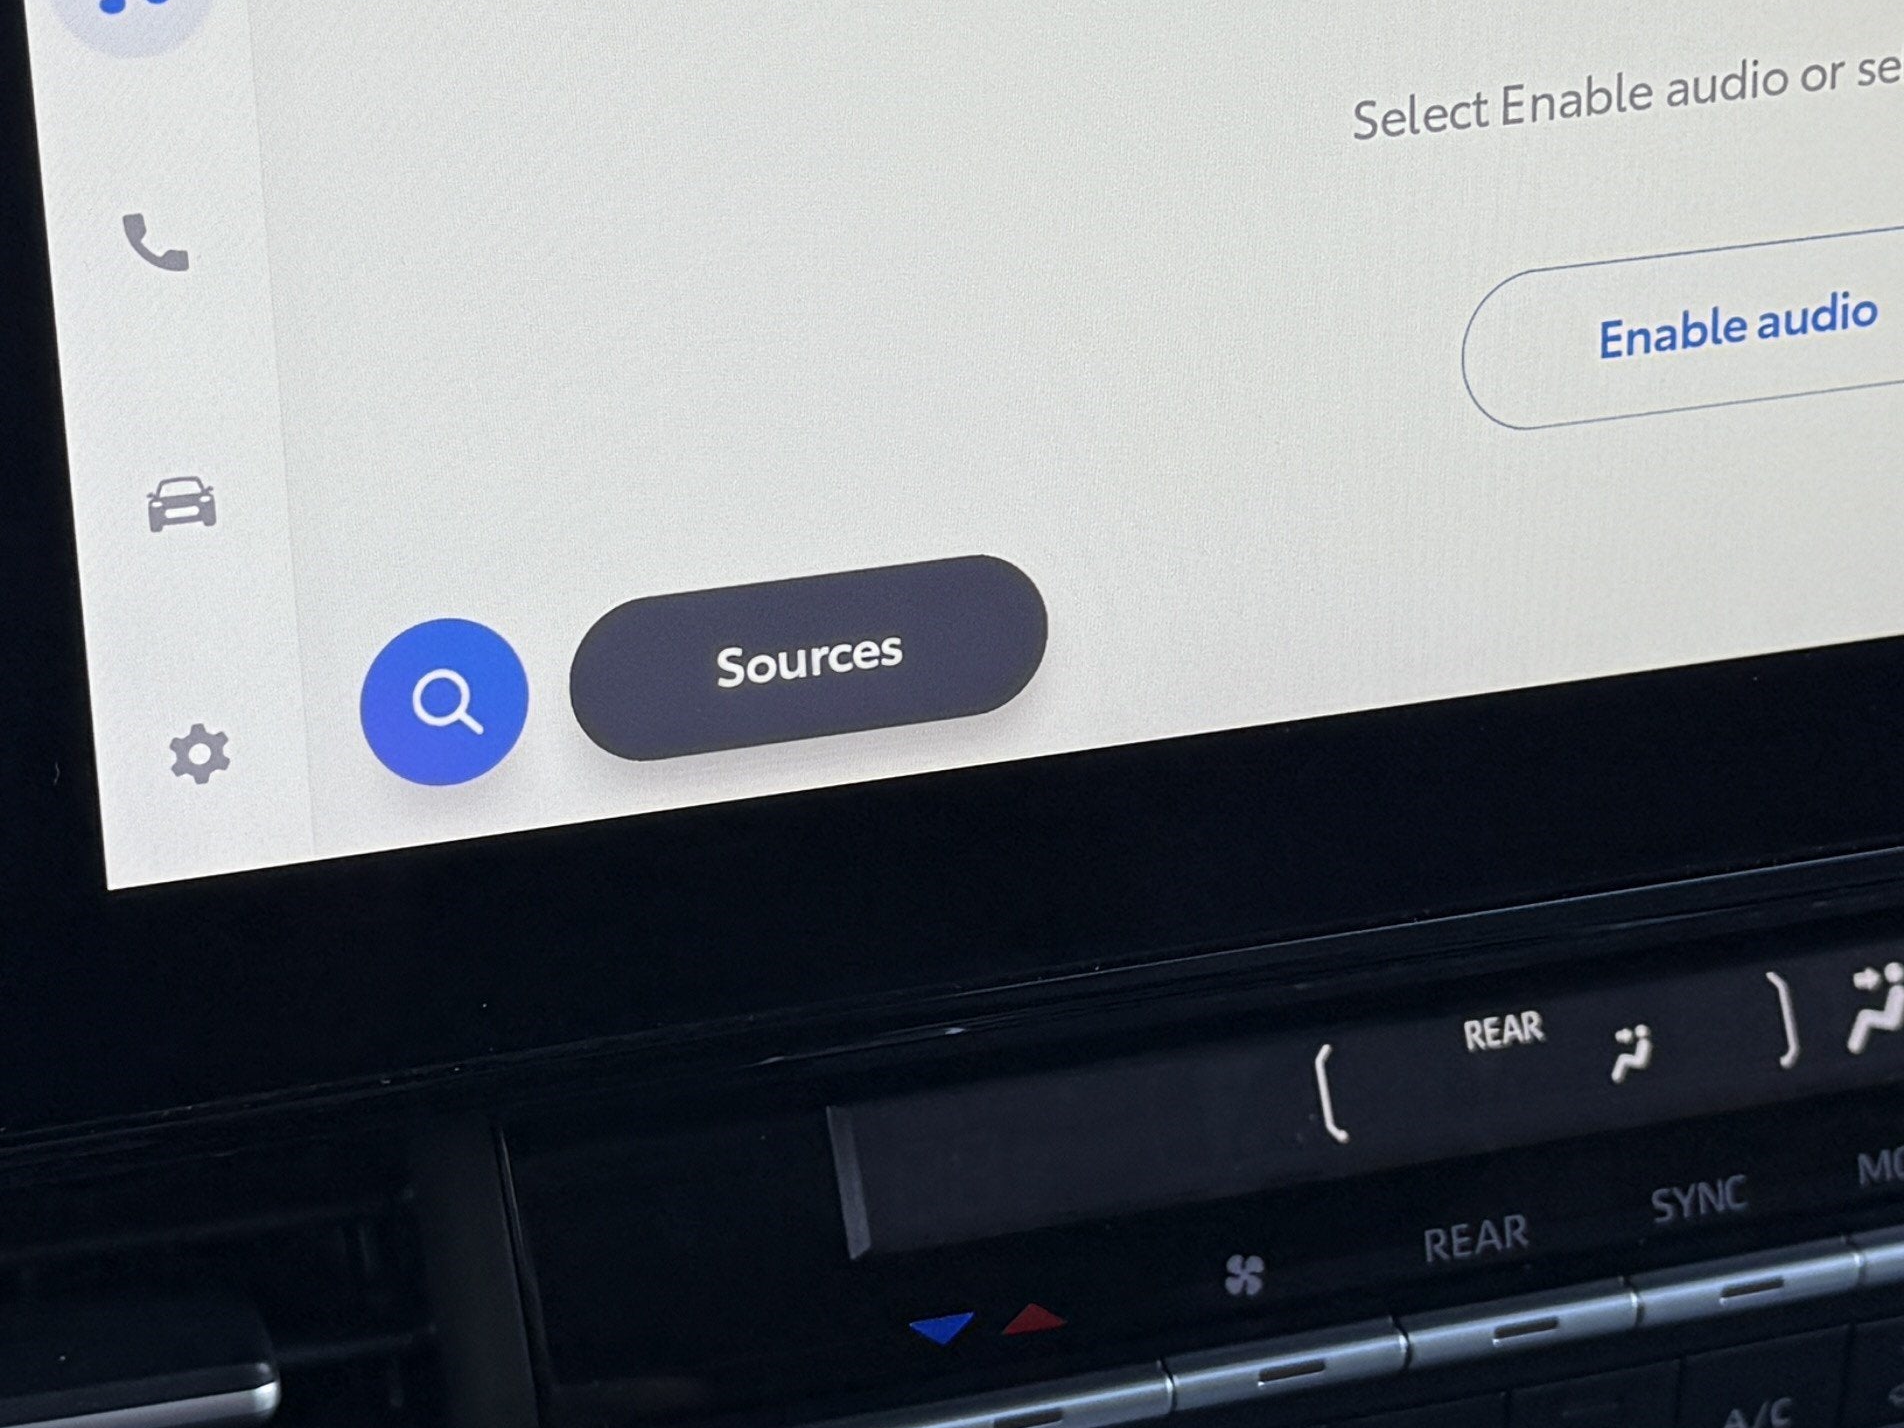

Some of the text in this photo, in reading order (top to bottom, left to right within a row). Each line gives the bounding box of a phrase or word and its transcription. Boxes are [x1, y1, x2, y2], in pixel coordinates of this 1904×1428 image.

[1353, 91, 1490, 141] Select
[1502, 71, 1654, 126] Enable
[1666, 58, 1789, 107] audio
[1800, 61, 1846, 92] or
[1600, 290, 1878, 360] Enable audio
[717, 637, 903, 688] Sources
[1463, 1010, 1544, 1051] REAR
[1651, 1173, 1748, 1224] SYNC
[1424, 1213, 1529, 1263] REAR
